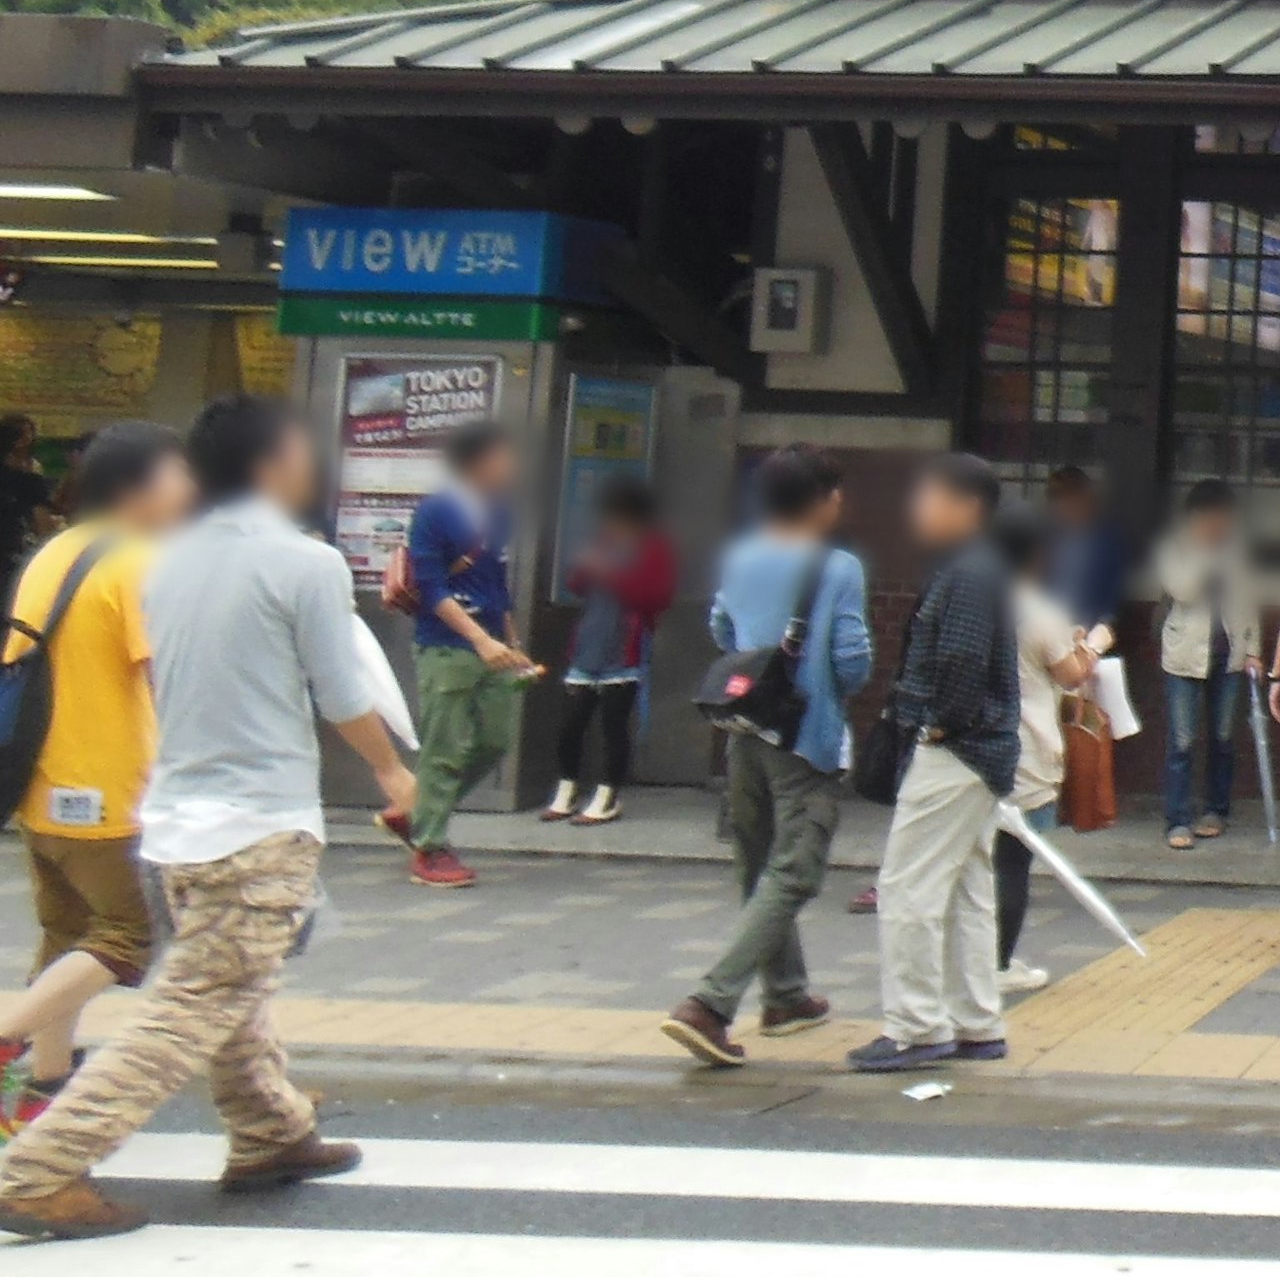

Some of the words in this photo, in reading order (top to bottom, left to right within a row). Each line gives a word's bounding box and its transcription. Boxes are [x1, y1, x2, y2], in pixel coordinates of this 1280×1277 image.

[458, 232, 516, 254] ATM
[405, 366, 484, 393] TOKYO
[405, 390, 486, 414] STATION
[405, 411, 484, 431] CAMP
